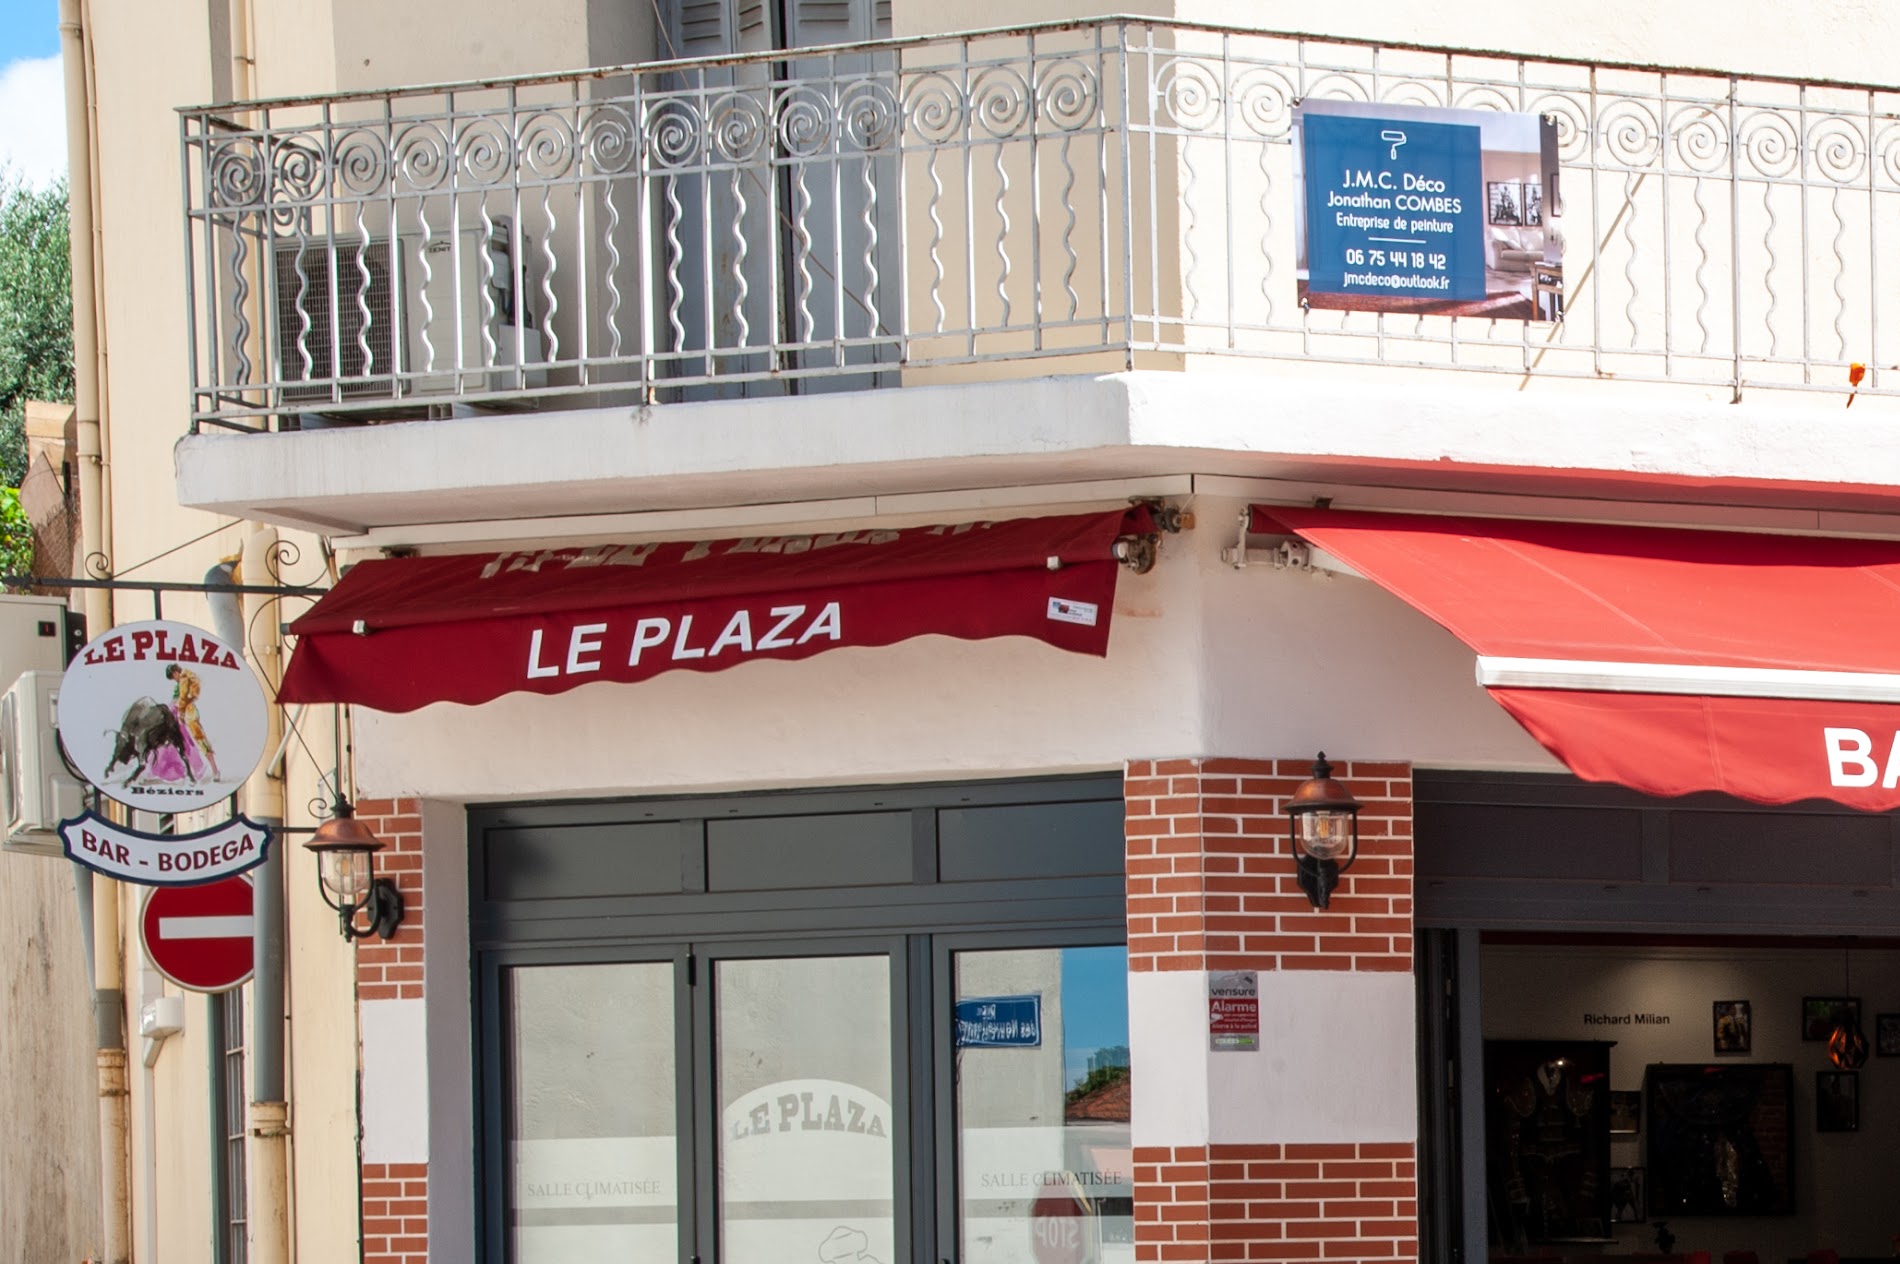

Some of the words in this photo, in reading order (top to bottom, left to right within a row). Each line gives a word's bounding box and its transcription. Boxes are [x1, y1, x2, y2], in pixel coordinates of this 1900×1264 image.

[1342, 170, 1397, 190] J.M.C.
[1403, 173, 1446, 193] Déco
[1327, 191, 1391, 209] Jonathan
[1395, 195, 1462, 214] COMBES
[1336, 212, 1390, 231] Entreprise
[1394, 216, 1407, 230] de
[1411, 217, 1453, 234] peinture
[1346, 249, 1364, 266] 06
[1368, 250, 1385, 267] 75
[1390, 251, 1407, 268] 44
[1411, 252, 1424, 268] 18
[1429, 253, 1446, 270] 42
[1343, 272, 1450, 290] jmcdeco@outlook.fr
[84, 636, 125, 666] LE
[131, 630, 240, 670] PLAZA
[526, 622, 607, 679] LE
[629, 601, 842, 666] PLAZA
[131, 785, 204, 796] Béziers
[81, 828, 130, 866] BAR
[158, 833, 255, 872] BODEGA
[1211, 1000, 1257, 1012] Alarme
[1584, 1013, 1631, 1025] Richard
[1634, 1013, 1670, 1025] Milian
[731, 1102, 771, 1141] LE
[777, 1092, 887, 1138] PLAZA
[527, 1183, 573, 1197] SALLE
[575, 1177, 661, 1196] CLIMATISÉE
[981, 1172, 1029, 1187] SALLE
[1033, 1168, 1123, 1186] CLIMATISÉE
